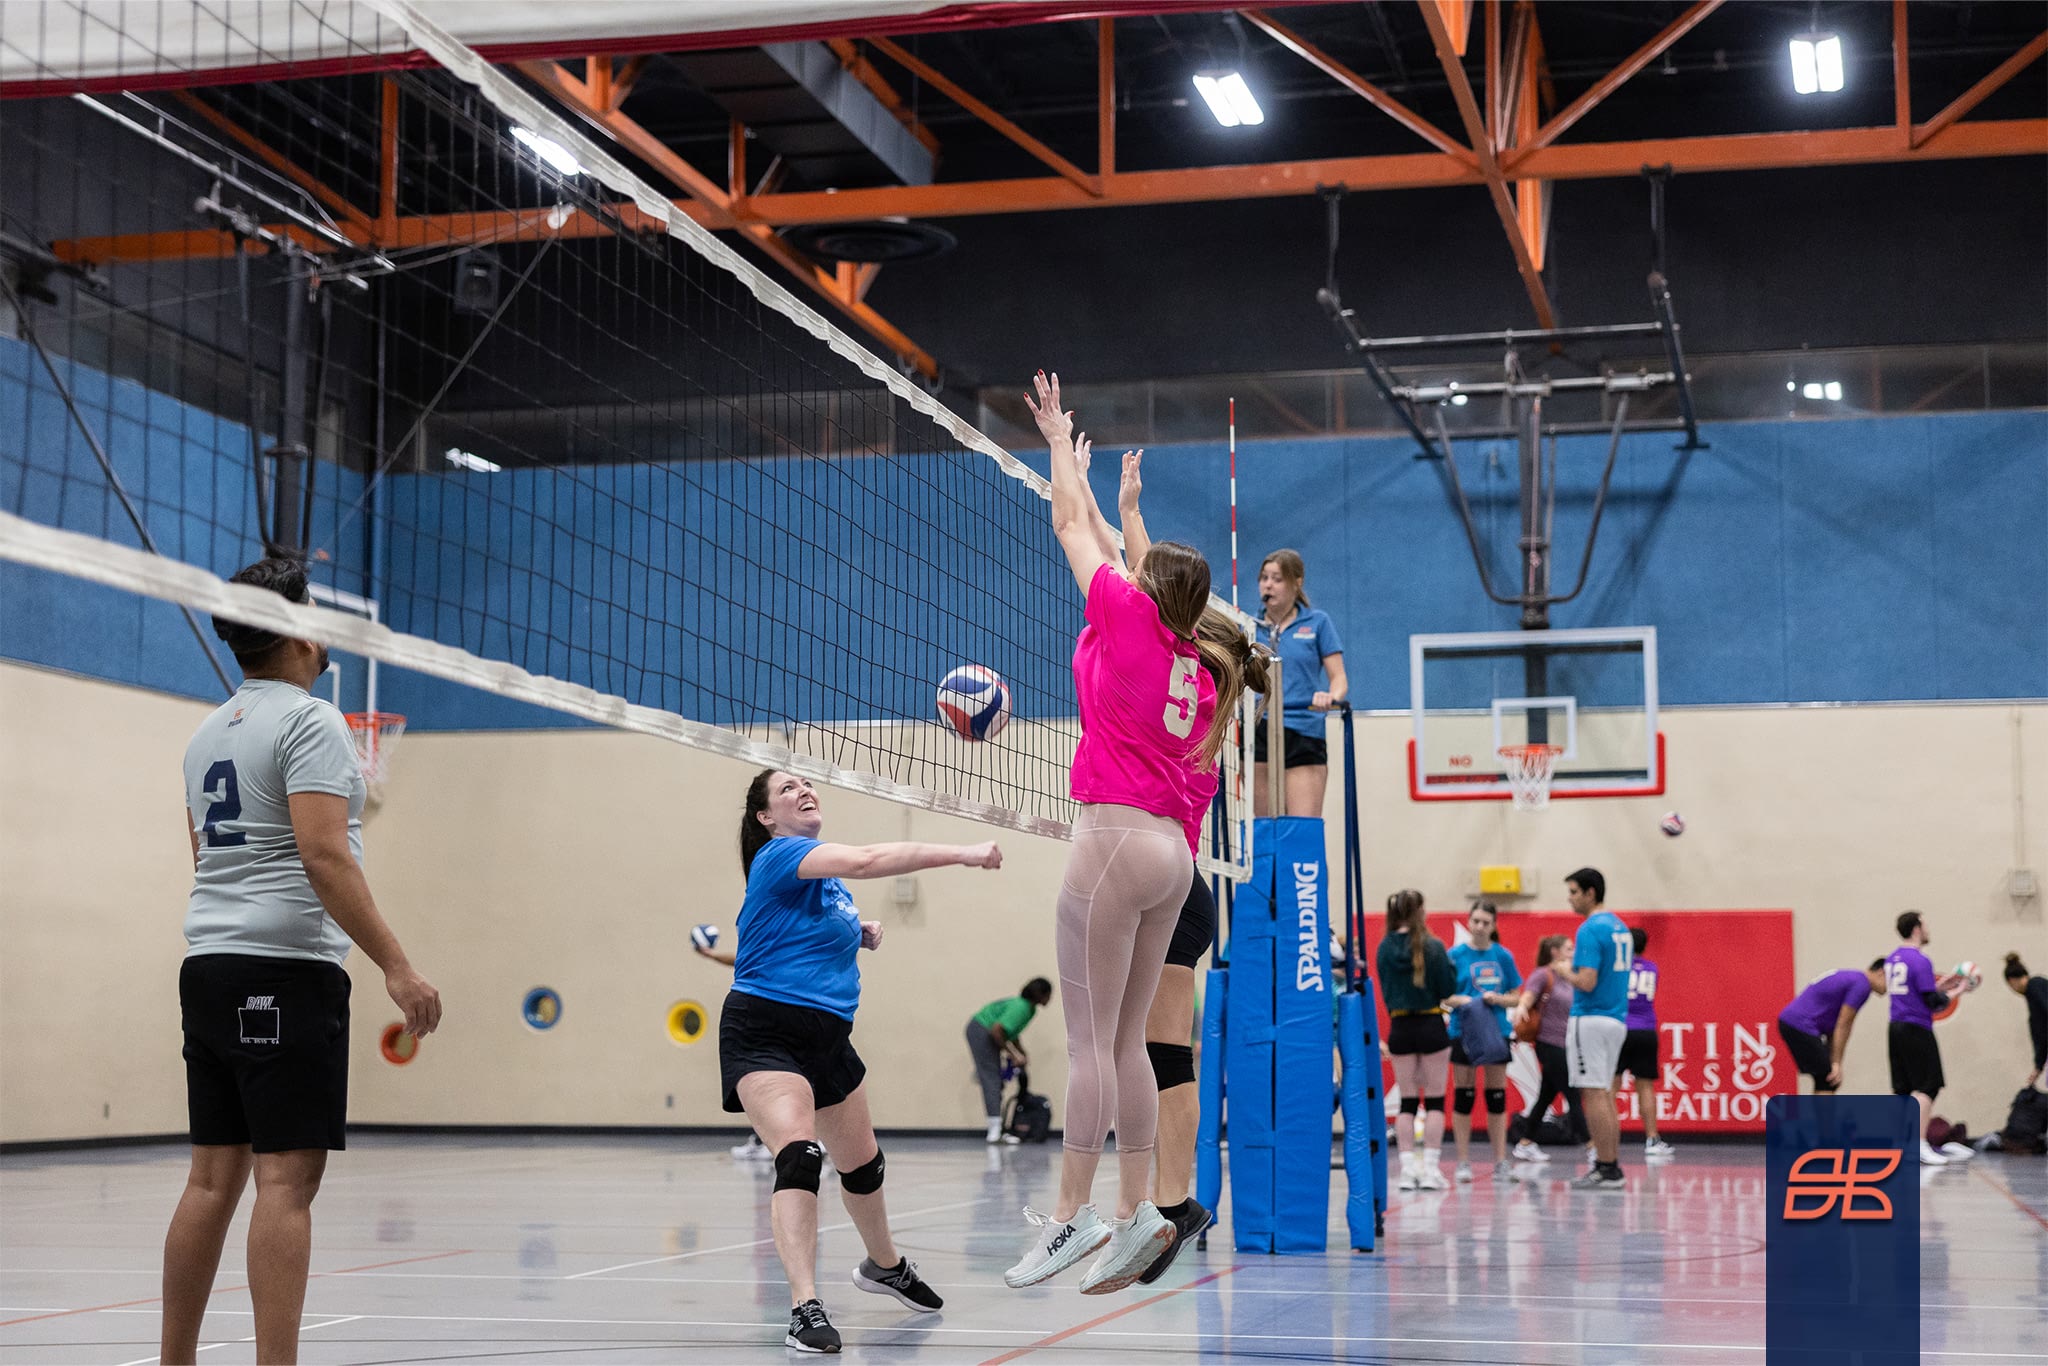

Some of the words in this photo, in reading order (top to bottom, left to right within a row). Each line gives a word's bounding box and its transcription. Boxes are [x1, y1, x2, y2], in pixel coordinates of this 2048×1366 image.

[1162, 651, 1198, 740] 5
[202, 759, 247, 847] 2
[1293, 862, 1324, 992] SPALDING
[1611, 932, 1634, 972] 11
[1884, 961, 1909, 995] 12
[1660, 1022, 1768, 1060] TIN
[1047, 1223, 1076, 1257] HOKA
